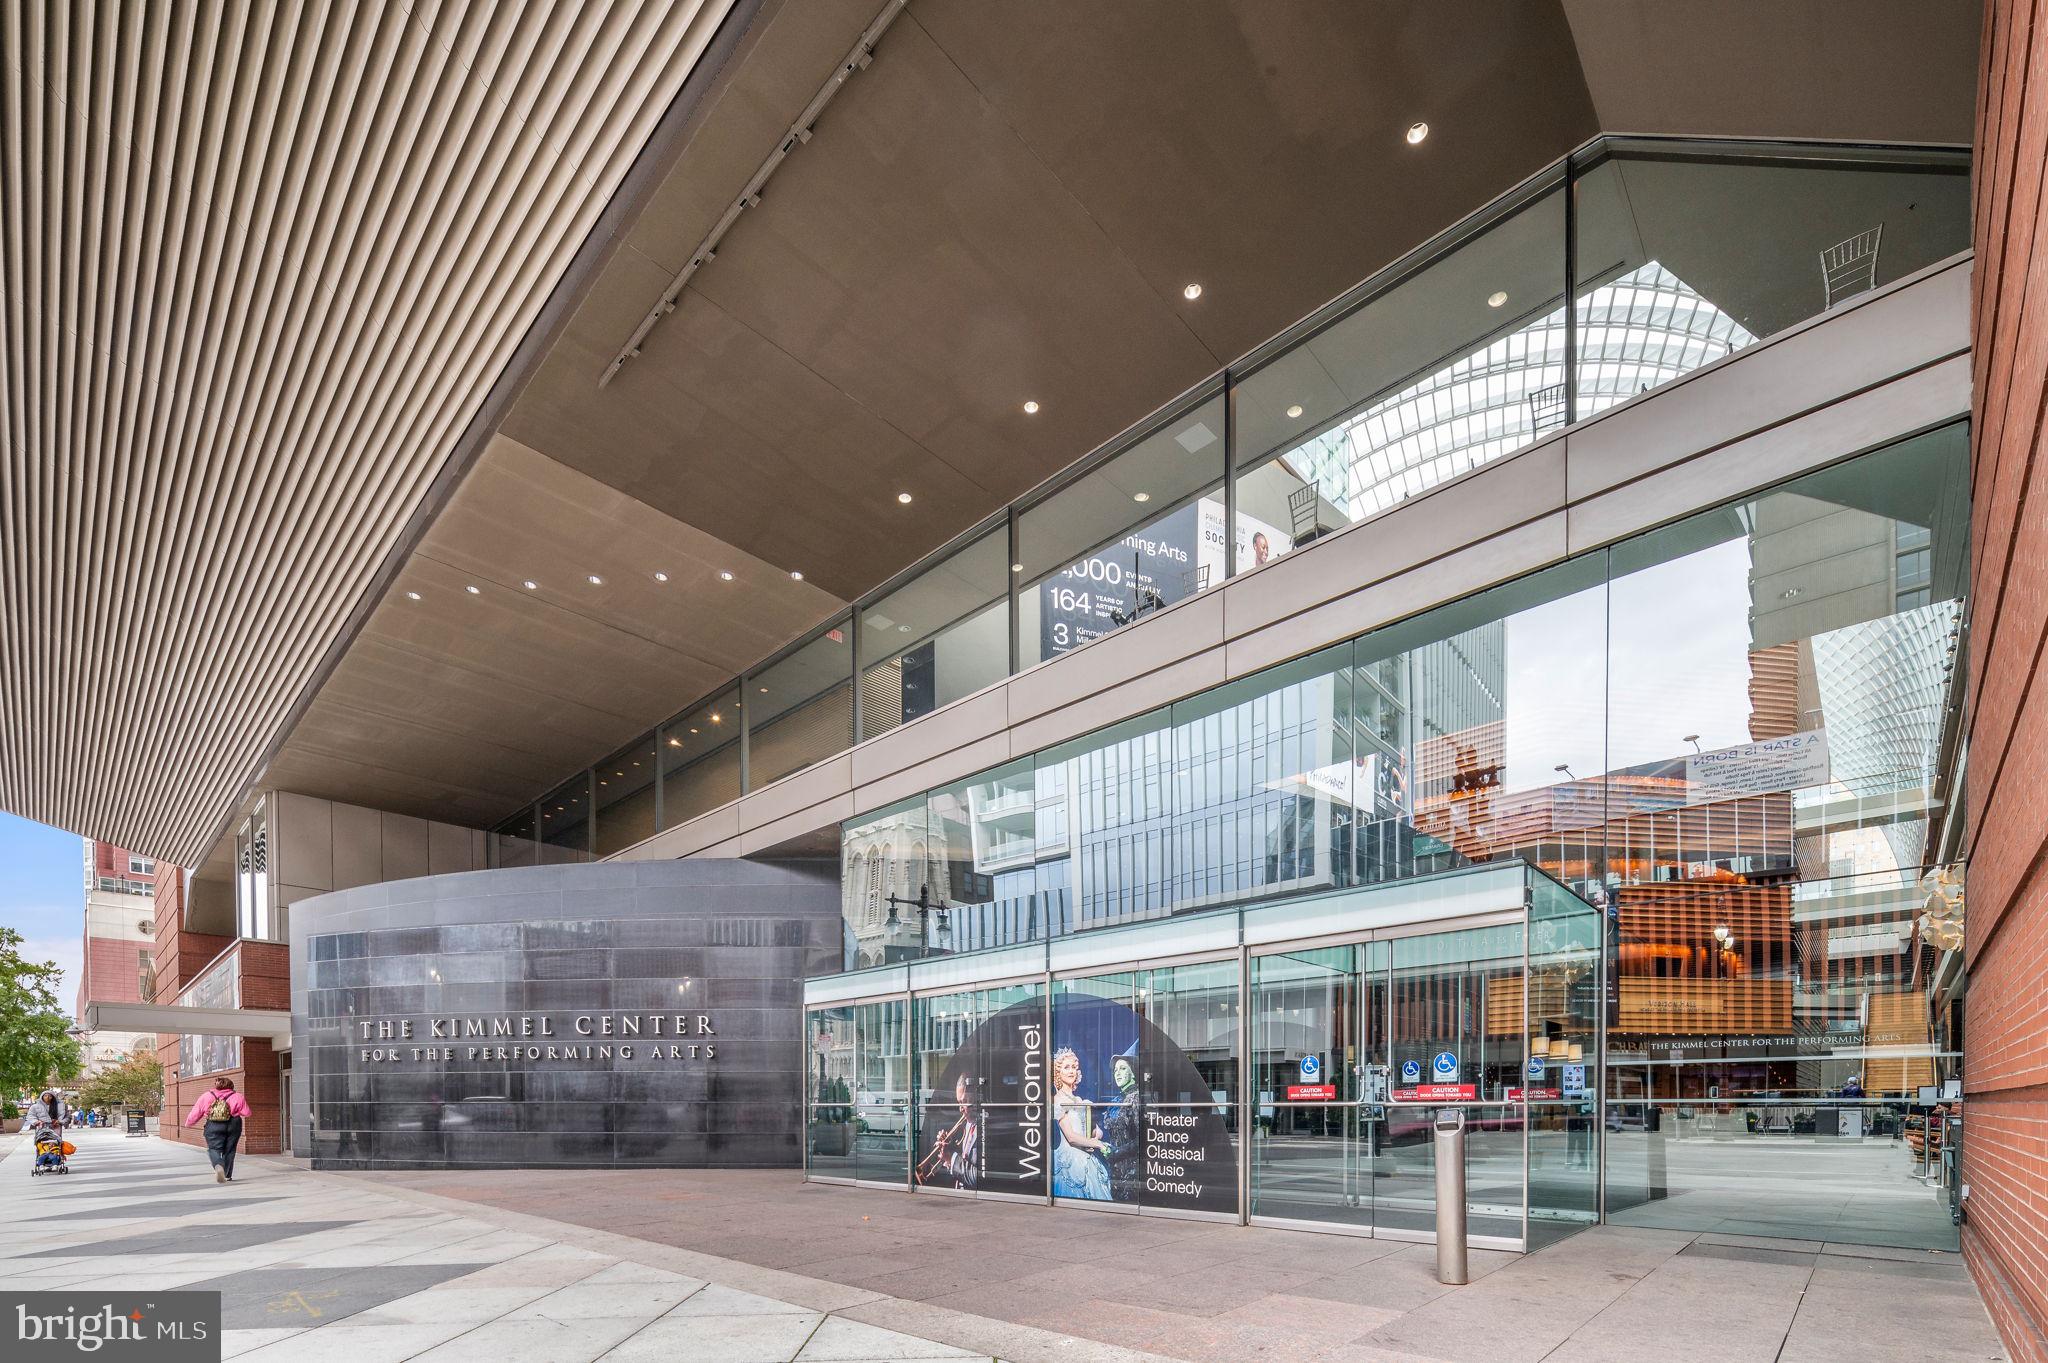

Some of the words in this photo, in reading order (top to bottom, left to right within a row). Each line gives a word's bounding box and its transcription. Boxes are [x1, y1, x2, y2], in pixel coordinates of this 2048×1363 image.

[1158, 541, 1188, 562] Arts
[1050, 587, 1092, 614] 164
[1095, 595, 1116, 605] YEARS
[1053, 623, 1069, 645] 3
[1076, 626, 1104, 638] Kimmel
[360, 1020, 411, 1038] THE
[430, 1016, 554, 1037] KIMMEL
[575, 1015, 715, 1035] CENTER
[1671, 1041, 1709, 1049] KIMMEL
[1710, 1039, 1750, 1048] CENTER
[1752, 1038, 1772, 1046] FOR
[1773, 1037, 1796, 1046] THE
[1798, 1035, 1871, 1045] PERFORMING
[1874, 1034, 1902, 1042] ARTS
[361, 1049, 400, 1061] FOR
[411, 1048, 453, 1061] THE
[468, 1045, 632, 1060] PERFORMING
[651, 1045, 715, 1058] ARTS
[1018, 1024, 1041, 1179] Welcome!
[1146, 1112, 1199, 1127] Theater
[1147, 1128, 1189, 1144] Dance
[1146, 1145, 1205, 1161] Classical
[1146, 1161, 1185, 1176] Music
[1146, 1177, 1202, 1198] Comedy
